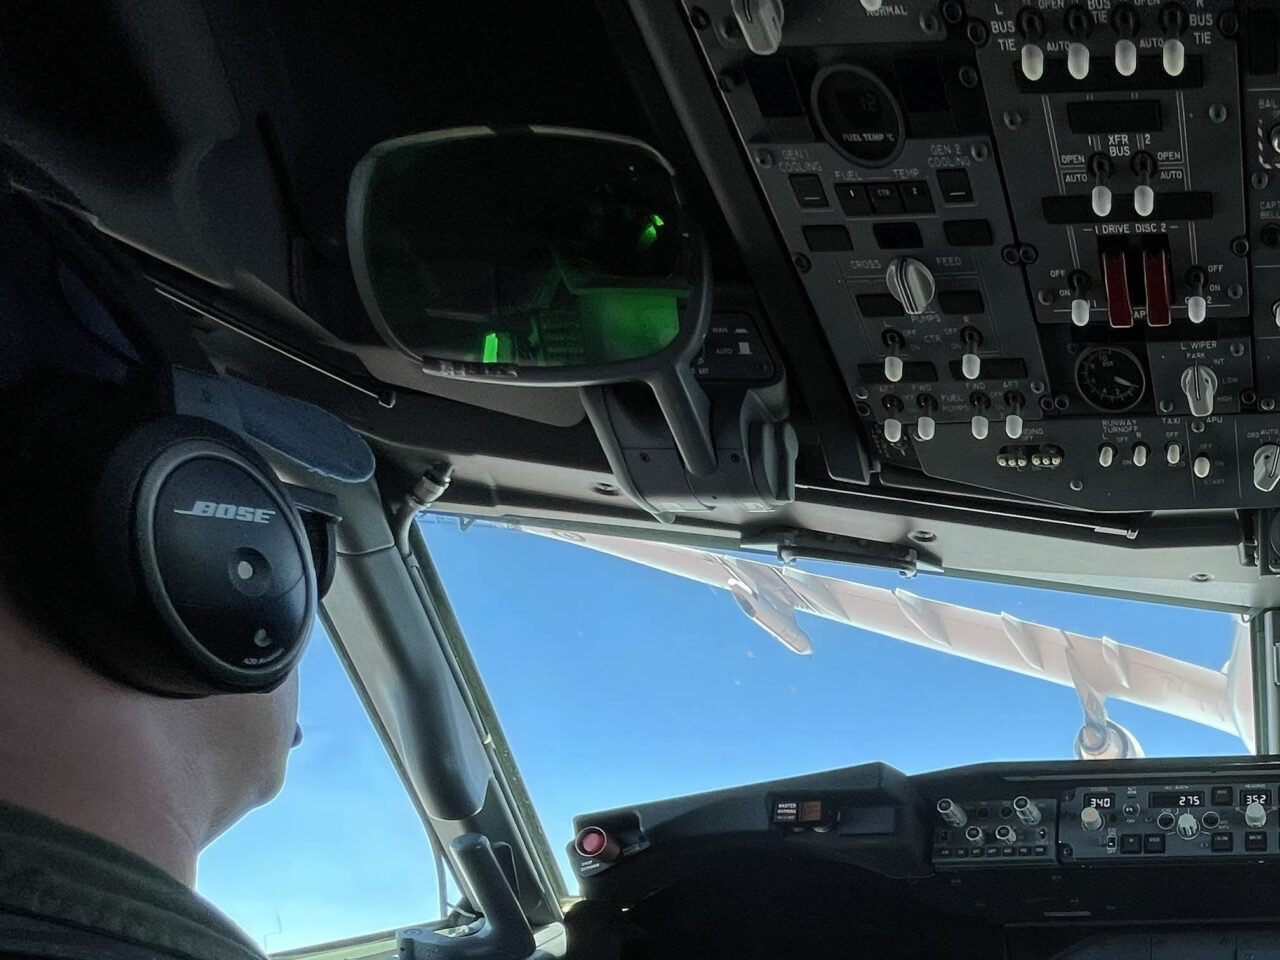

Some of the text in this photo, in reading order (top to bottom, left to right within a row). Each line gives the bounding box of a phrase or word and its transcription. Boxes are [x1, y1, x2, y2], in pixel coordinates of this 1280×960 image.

[995, 2, 1004, 15] L
[1092, 12, 1109, 24] TIE
[1189, 13, 1214, 26] BUS
[990, 20, 1016, 34] BUS
[1139, 38, 1164, 48] AUTO
[1194, 32, 1212, 44] TIE
[998, 39, 1017, 51] TIE
[1046, 41, 1071, 51] AUTO
[863, 133, 885, 141] TEMP
[1107, 134, 1129, 145] XFR
[1144, 134, 1152, 145] 2
[930, 145, 950, 155] GEN
[1109, 146, 1131, 157] BUS
[1061, 154, 1086, 164] OPEN
[1157, 151, 1181, 162] OPEN
[927, 156, 972, 168] COOLING
[833, 167, 920, 181] FUEL TEMP
[1065, 173, 1088, 183] AUTO
[1160, 170, 1183, 180] AUTO
[1260, 201, 1280, 211] CAPT
[1101, 224, 1131, 235] DRIVE
[1135, 223, 1159, 233] DISC
[1160, 223, 1167, 232] 2
[850, 257, 962, 270] CROSS FEED
[1207, 264, 1224, 273] OFF
[1050, 270, 1066, 278] OFF
[1059, 289, 1071, 297] ON
[1209, 284, 1222, 292] ON
[1191, 341, 1217, 350] WIPER
[1187, 352, 1205, 360] PARK
[1222, 376, 1239, 384] LOW
[1102, 419, 1137, 428] RUNWAY
[1161, 417, 1181, 425] TAXI
[1206, 416, 1223, 425] APU
[1103, 426, 1139, 434] TURNOFF
[174, 501, 276, 523] BOSE
[1090, 798, 1111, 808] 340
[1179, 796, 1200, 806] 275
[1246, 795, 1267, 804] 352
